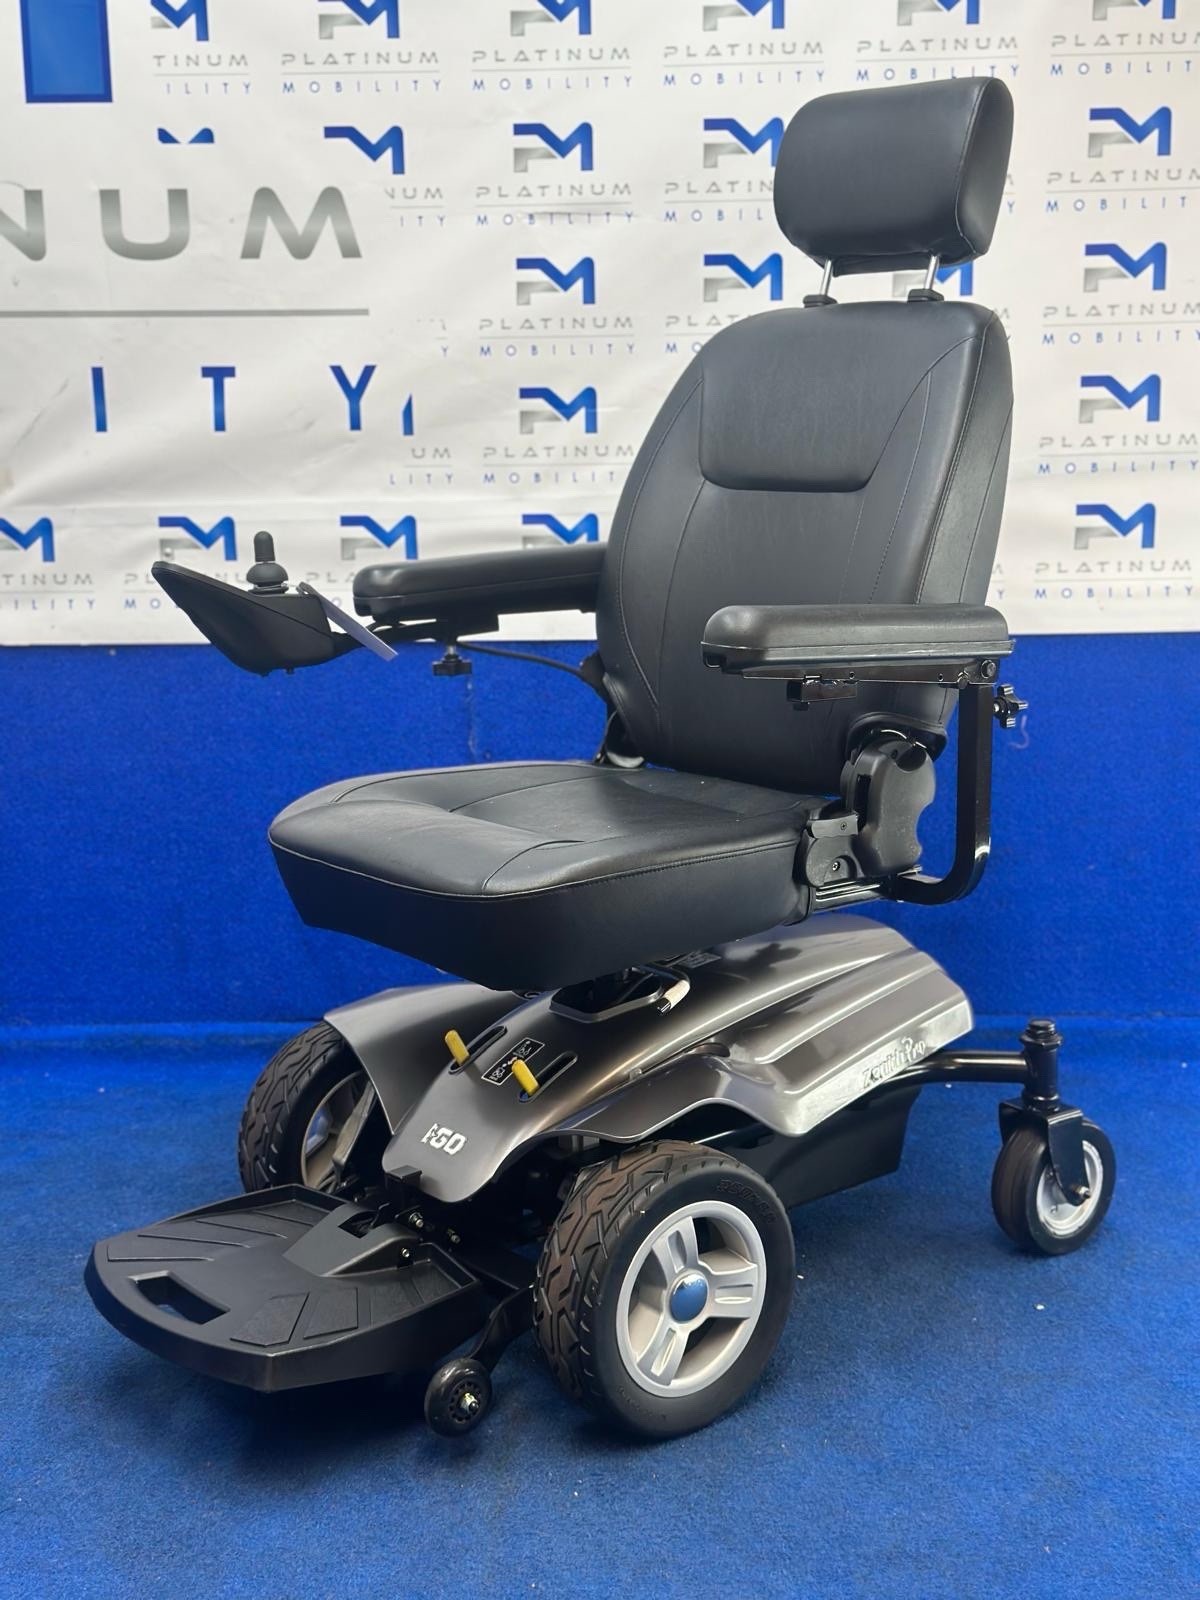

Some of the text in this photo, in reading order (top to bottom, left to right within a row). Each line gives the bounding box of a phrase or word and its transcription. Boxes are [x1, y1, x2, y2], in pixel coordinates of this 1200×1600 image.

[664, 42, 823, 58] PLATINUM
[857, 36, 1018, 53] PLATINUM
[282, 51, 438, 65] PLATINUM
[472, 48, 630, 62] PLATINUM
[472, 76, 631, 90] MOBILITY
[664, 70, 824, 85] MOBILITY
[283, 80, 440, 93] MOBILITY
[476, 183, 631, 198] PLATINUM
[477, 212, 634, 225] MOBILITY
[479, 317, 632, 330] PLATINUM
[480, 344, 634, 356] MOBILITY
[1040, 434, 1197, 448] PLATINUM
[483, 445, 634, 458] PLATINUM
[1038, 460, 1198, 474] MOBILITY
[1035, 560, 1191, 573] PLATINUM
[1035, 586, 1192, 599] MOBILITY
